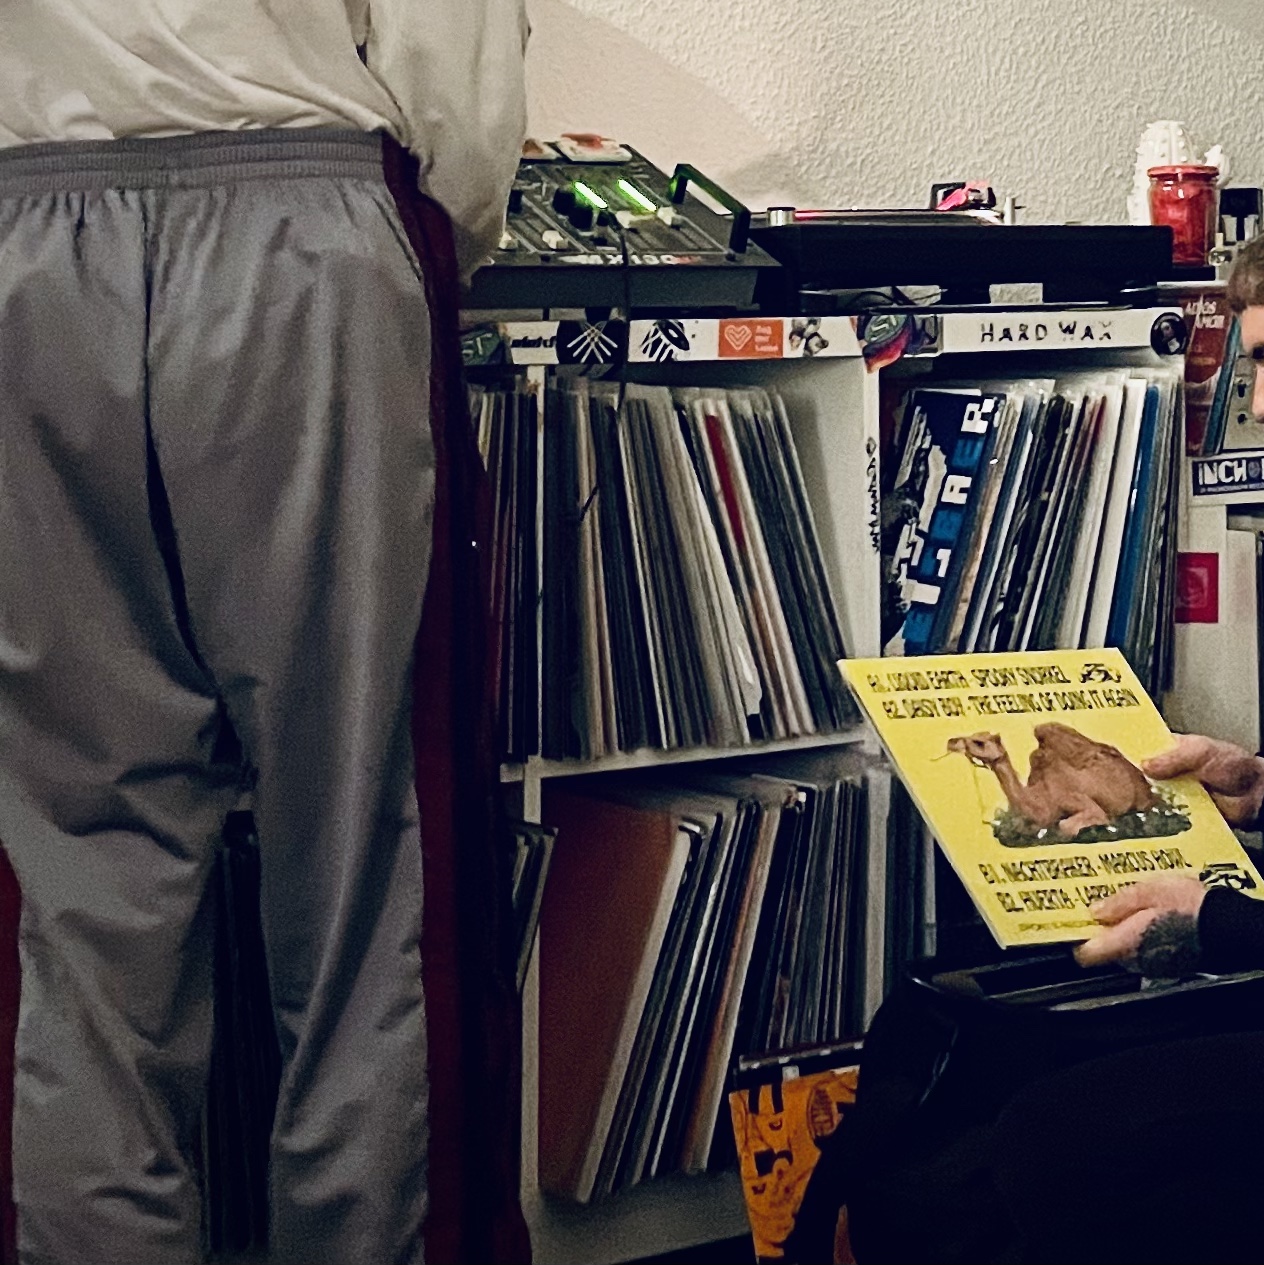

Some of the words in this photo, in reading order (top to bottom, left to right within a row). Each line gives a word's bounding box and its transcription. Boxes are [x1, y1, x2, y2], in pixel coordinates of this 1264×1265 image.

[980, 323, 1048, 343] HARD
[1058, 321, 1113, 341] WAX
[1198, 459, 1248, 485] INCH
